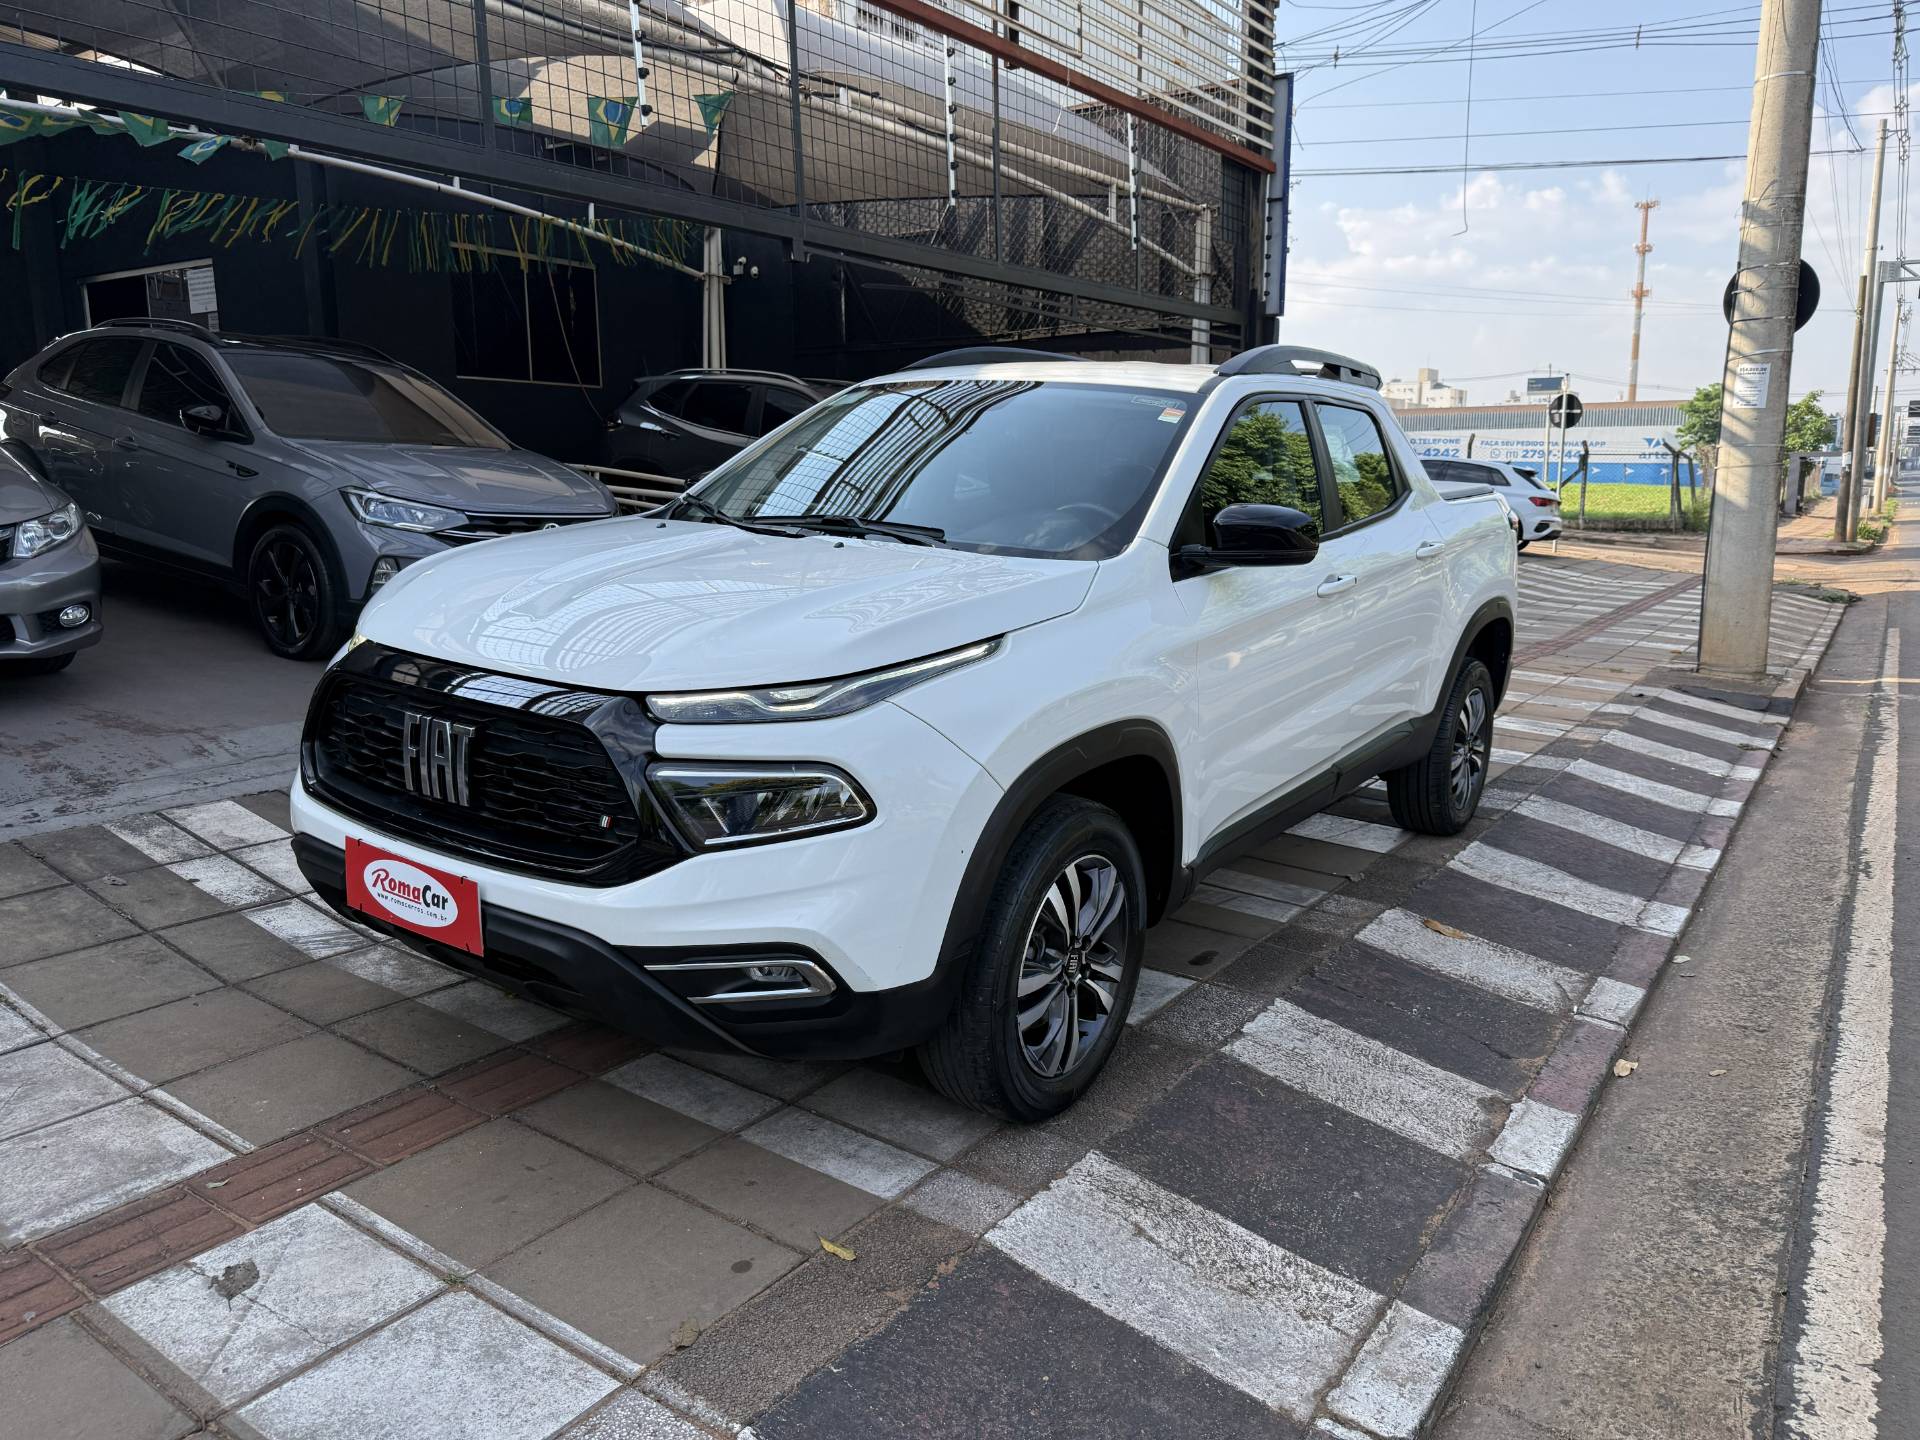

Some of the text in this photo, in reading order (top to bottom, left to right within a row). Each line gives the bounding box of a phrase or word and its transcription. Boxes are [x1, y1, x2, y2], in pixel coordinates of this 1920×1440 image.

[1414, 448, 1460, 458] -4242
[403, 711, 476, 807] FIAT
[372, 868, 448, 910] RomaCar
